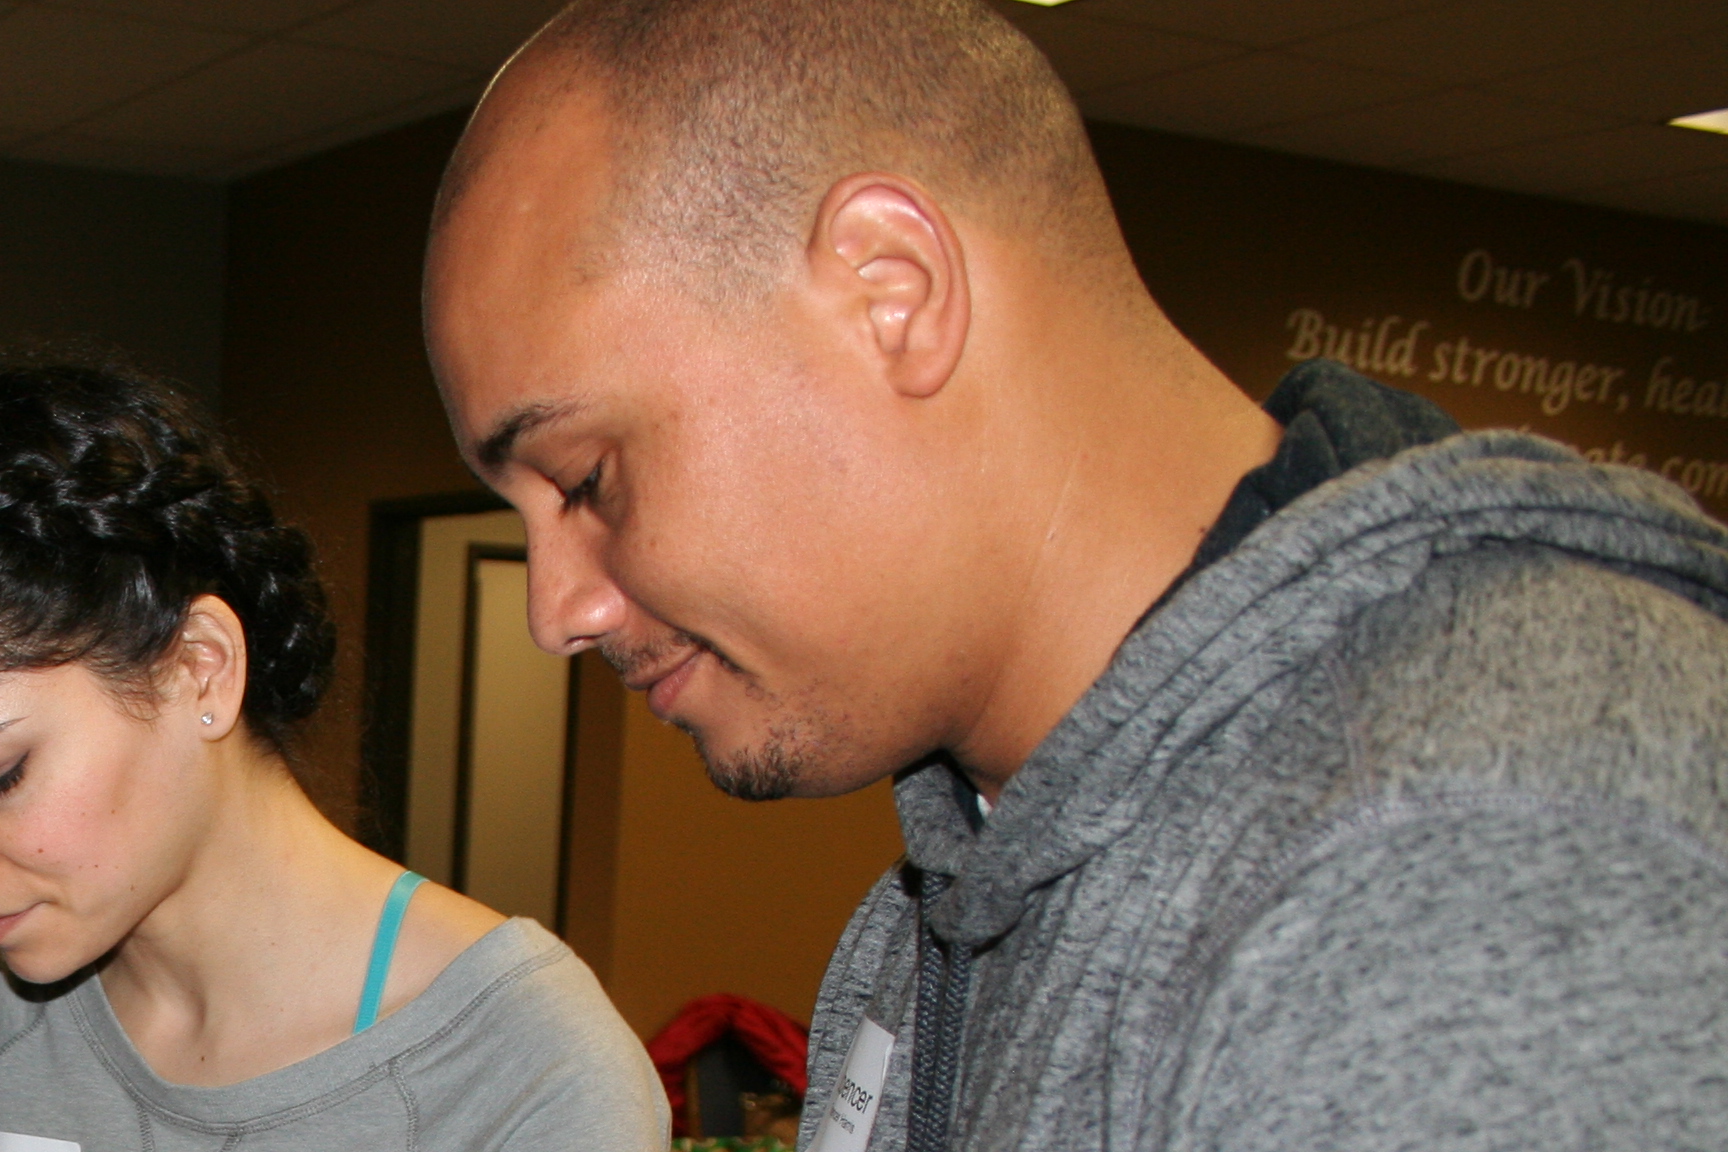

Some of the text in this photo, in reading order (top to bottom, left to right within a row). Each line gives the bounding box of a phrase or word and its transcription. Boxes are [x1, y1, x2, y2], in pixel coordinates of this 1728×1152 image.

[1457, 248, 1550, 309] Our
[1286, 308, 1433, 376] Build
[1429, 336, 1630, 416] stronger,
